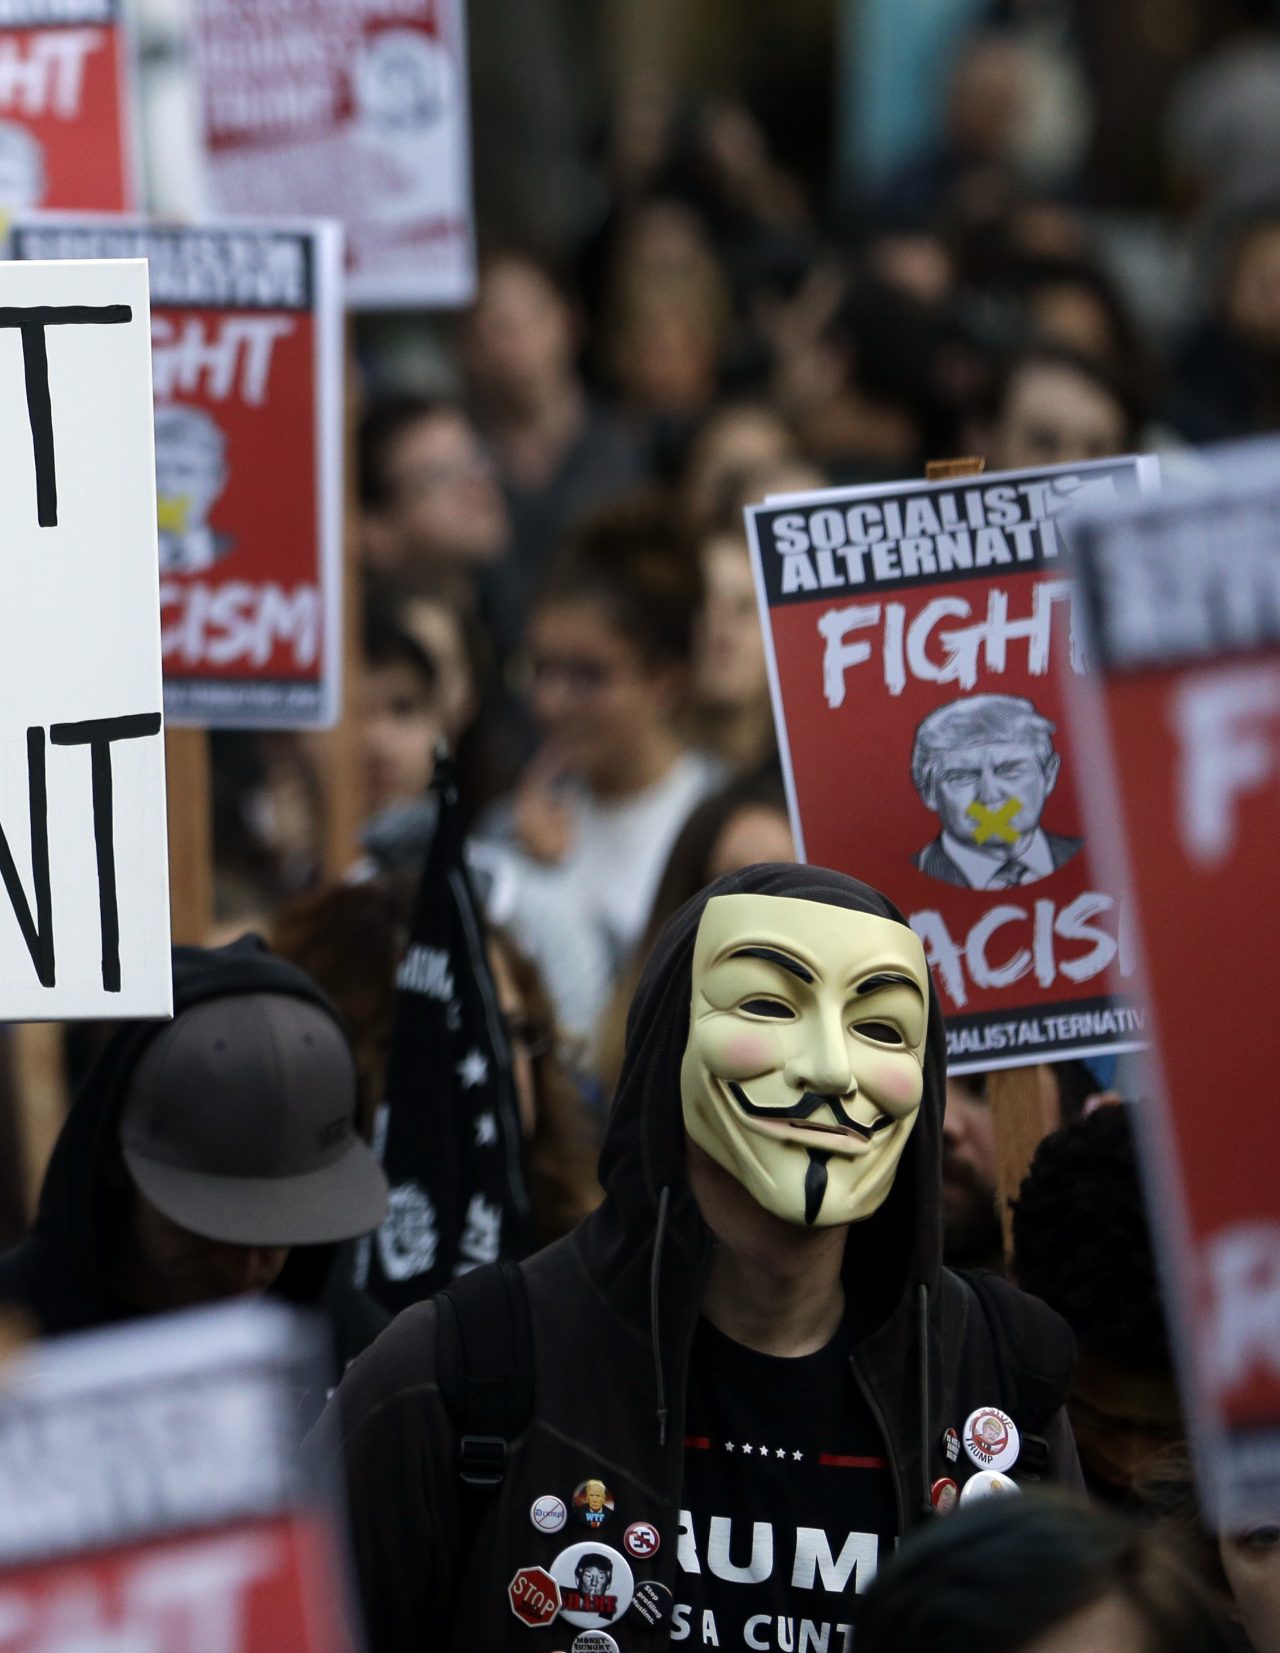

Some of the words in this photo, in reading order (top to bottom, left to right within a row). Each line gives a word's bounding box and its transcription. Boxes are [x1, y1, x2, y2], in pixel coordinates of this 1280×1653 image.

[772, 479, 1052, 556] SOCIALIST
[780, 518, 1059, 594] ALTERNATI
[907, 892, 1138, 1011] ACIS
[586, 1512, 605, 1522] WTF
[512, 1575, 555, 1617] STOP
[636, 1591, 662, 1619] profiling
[643, 1585, 659, 1601] Stop
[702, 1609, 720, 1647] A
